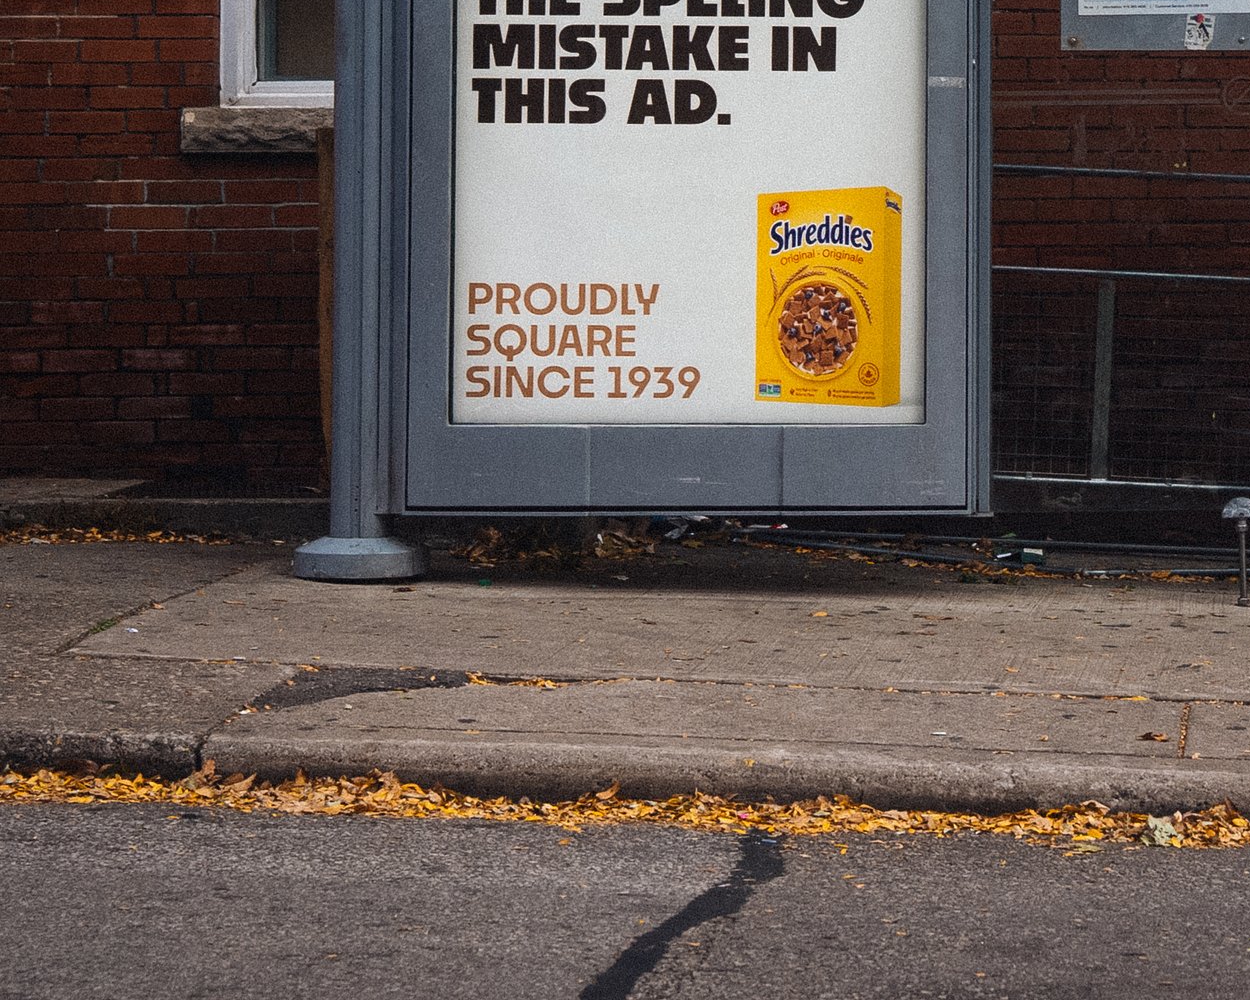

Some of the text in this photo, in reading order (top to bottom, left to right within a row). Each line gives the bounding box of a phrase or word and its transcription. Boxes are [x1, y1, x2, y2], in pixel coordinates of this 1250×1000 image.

[472, 24, 837, 72] MISTAKE IN
[471, 78, 731, 125] THIS AD.
[772, 202, 789, 215] Post
[770, 214, 873, 255] Shreddies
[780, 248, 864, 265] Original Originale
[467, 282, 660, 316] PROUDLY
[466, 324, 636, 362] SQUARE
[465, 365, 702, 399] SINCE 1939
